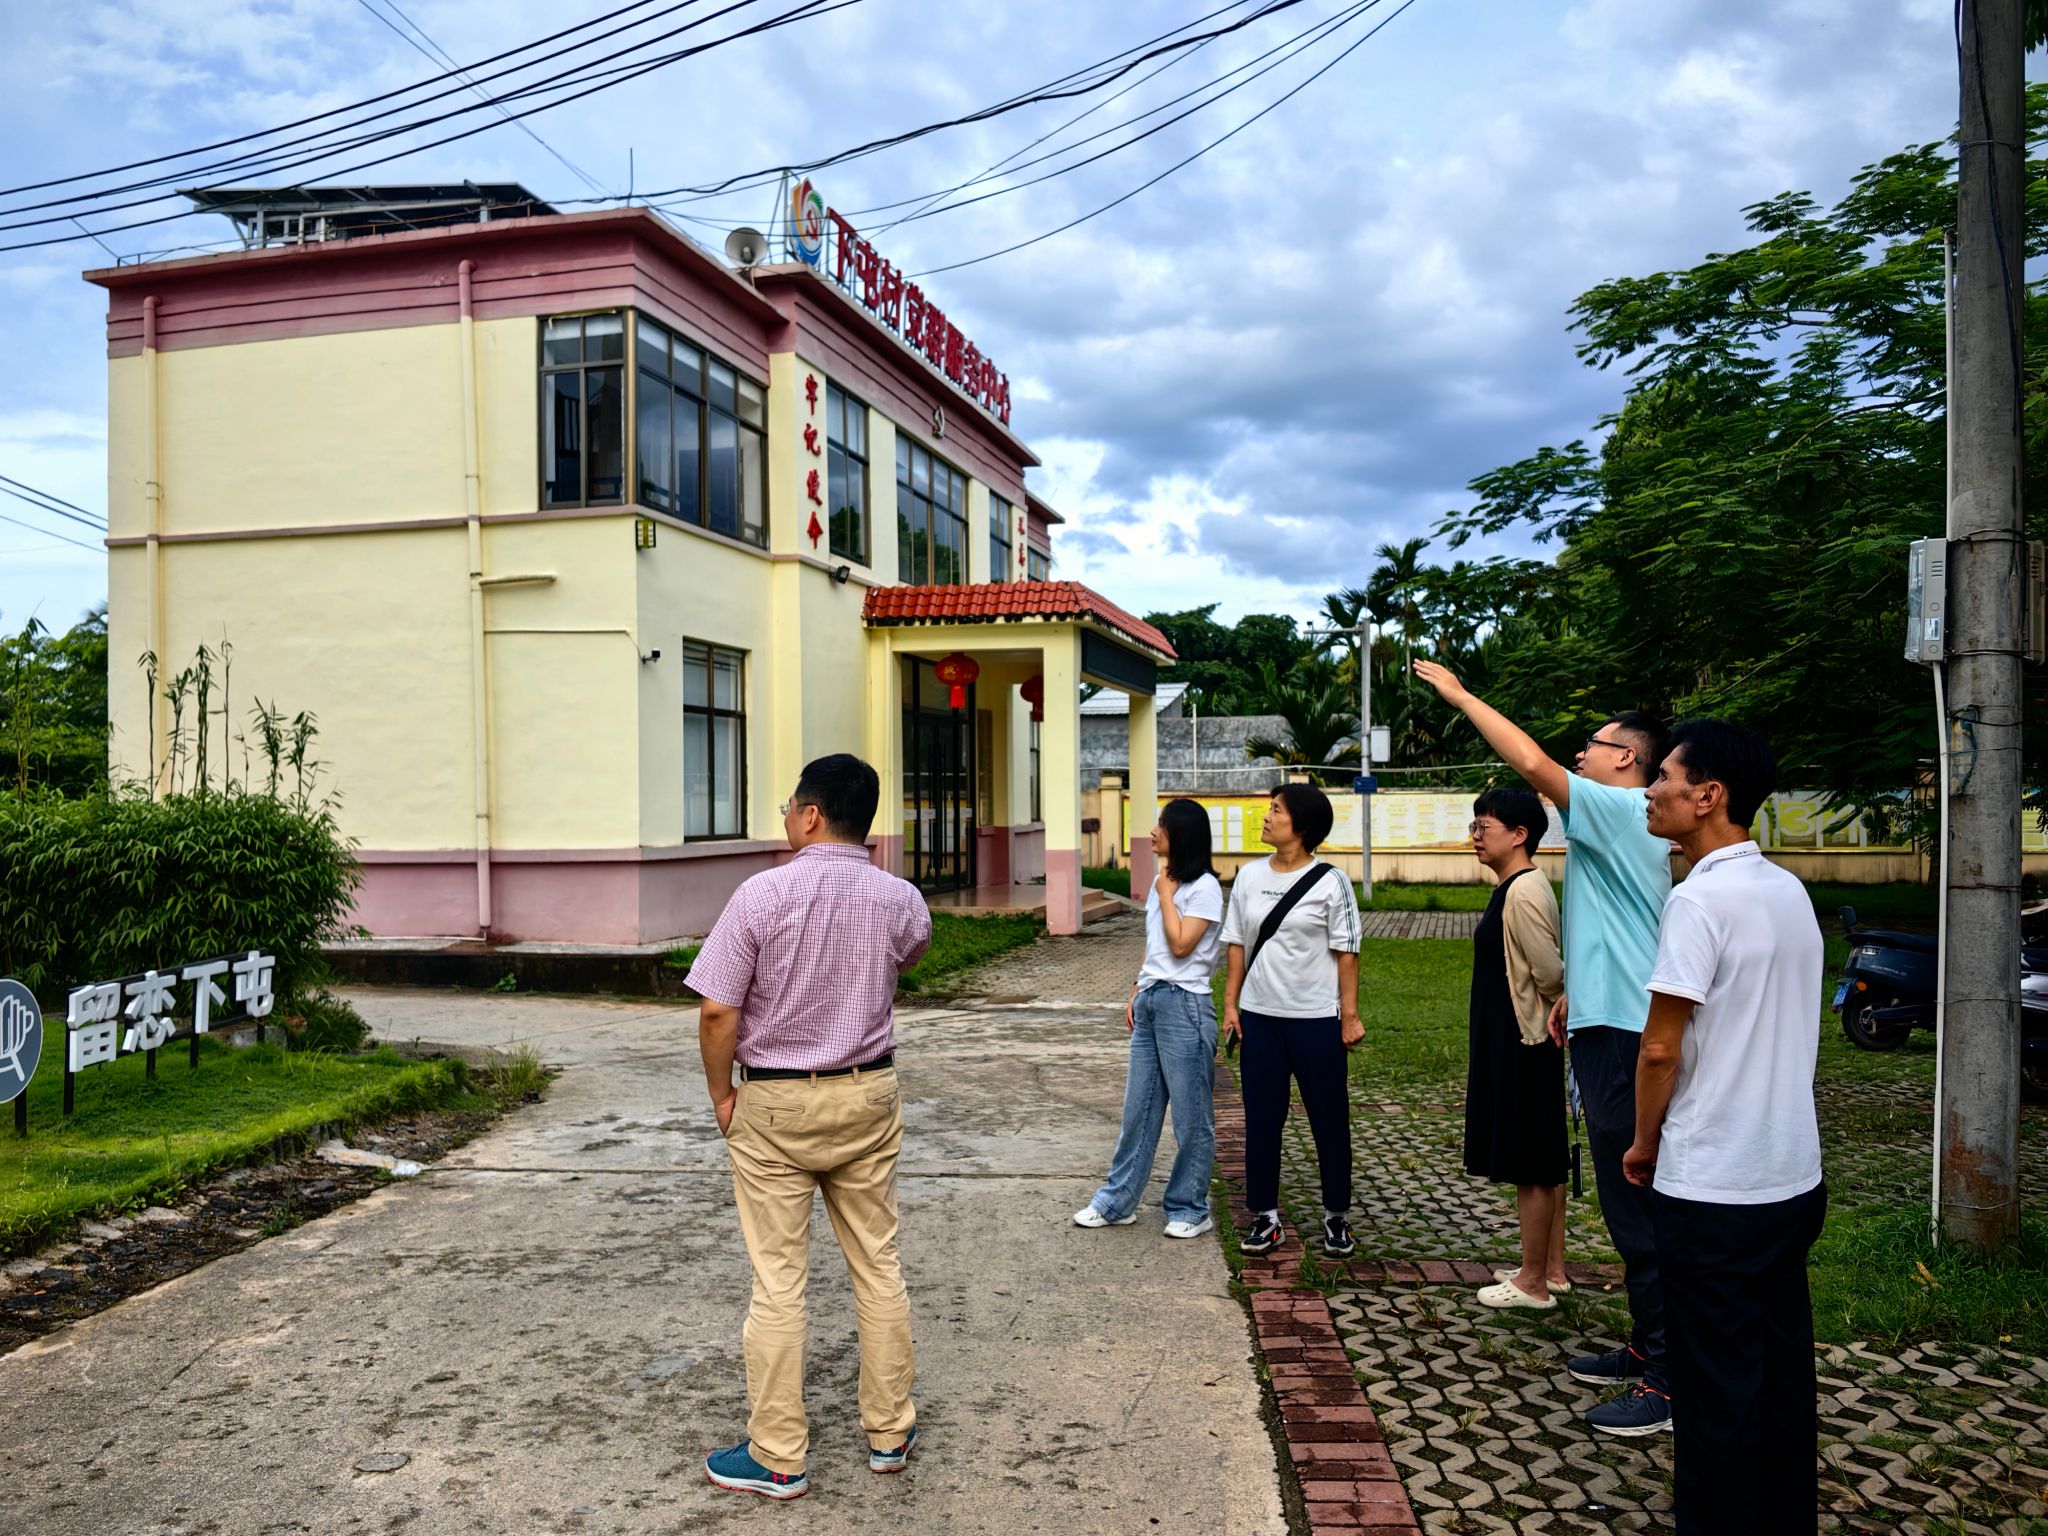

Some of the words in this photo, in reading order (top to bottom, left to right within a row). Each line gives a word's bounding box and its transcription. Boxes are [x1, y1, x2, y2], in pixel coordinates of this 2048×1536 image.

[827, 206, 1012, 424] 下屯村党群服务中心
[803, 373, 824, 550] 牢记使命
[66, 949, 276, 1073] 留恋下屯
